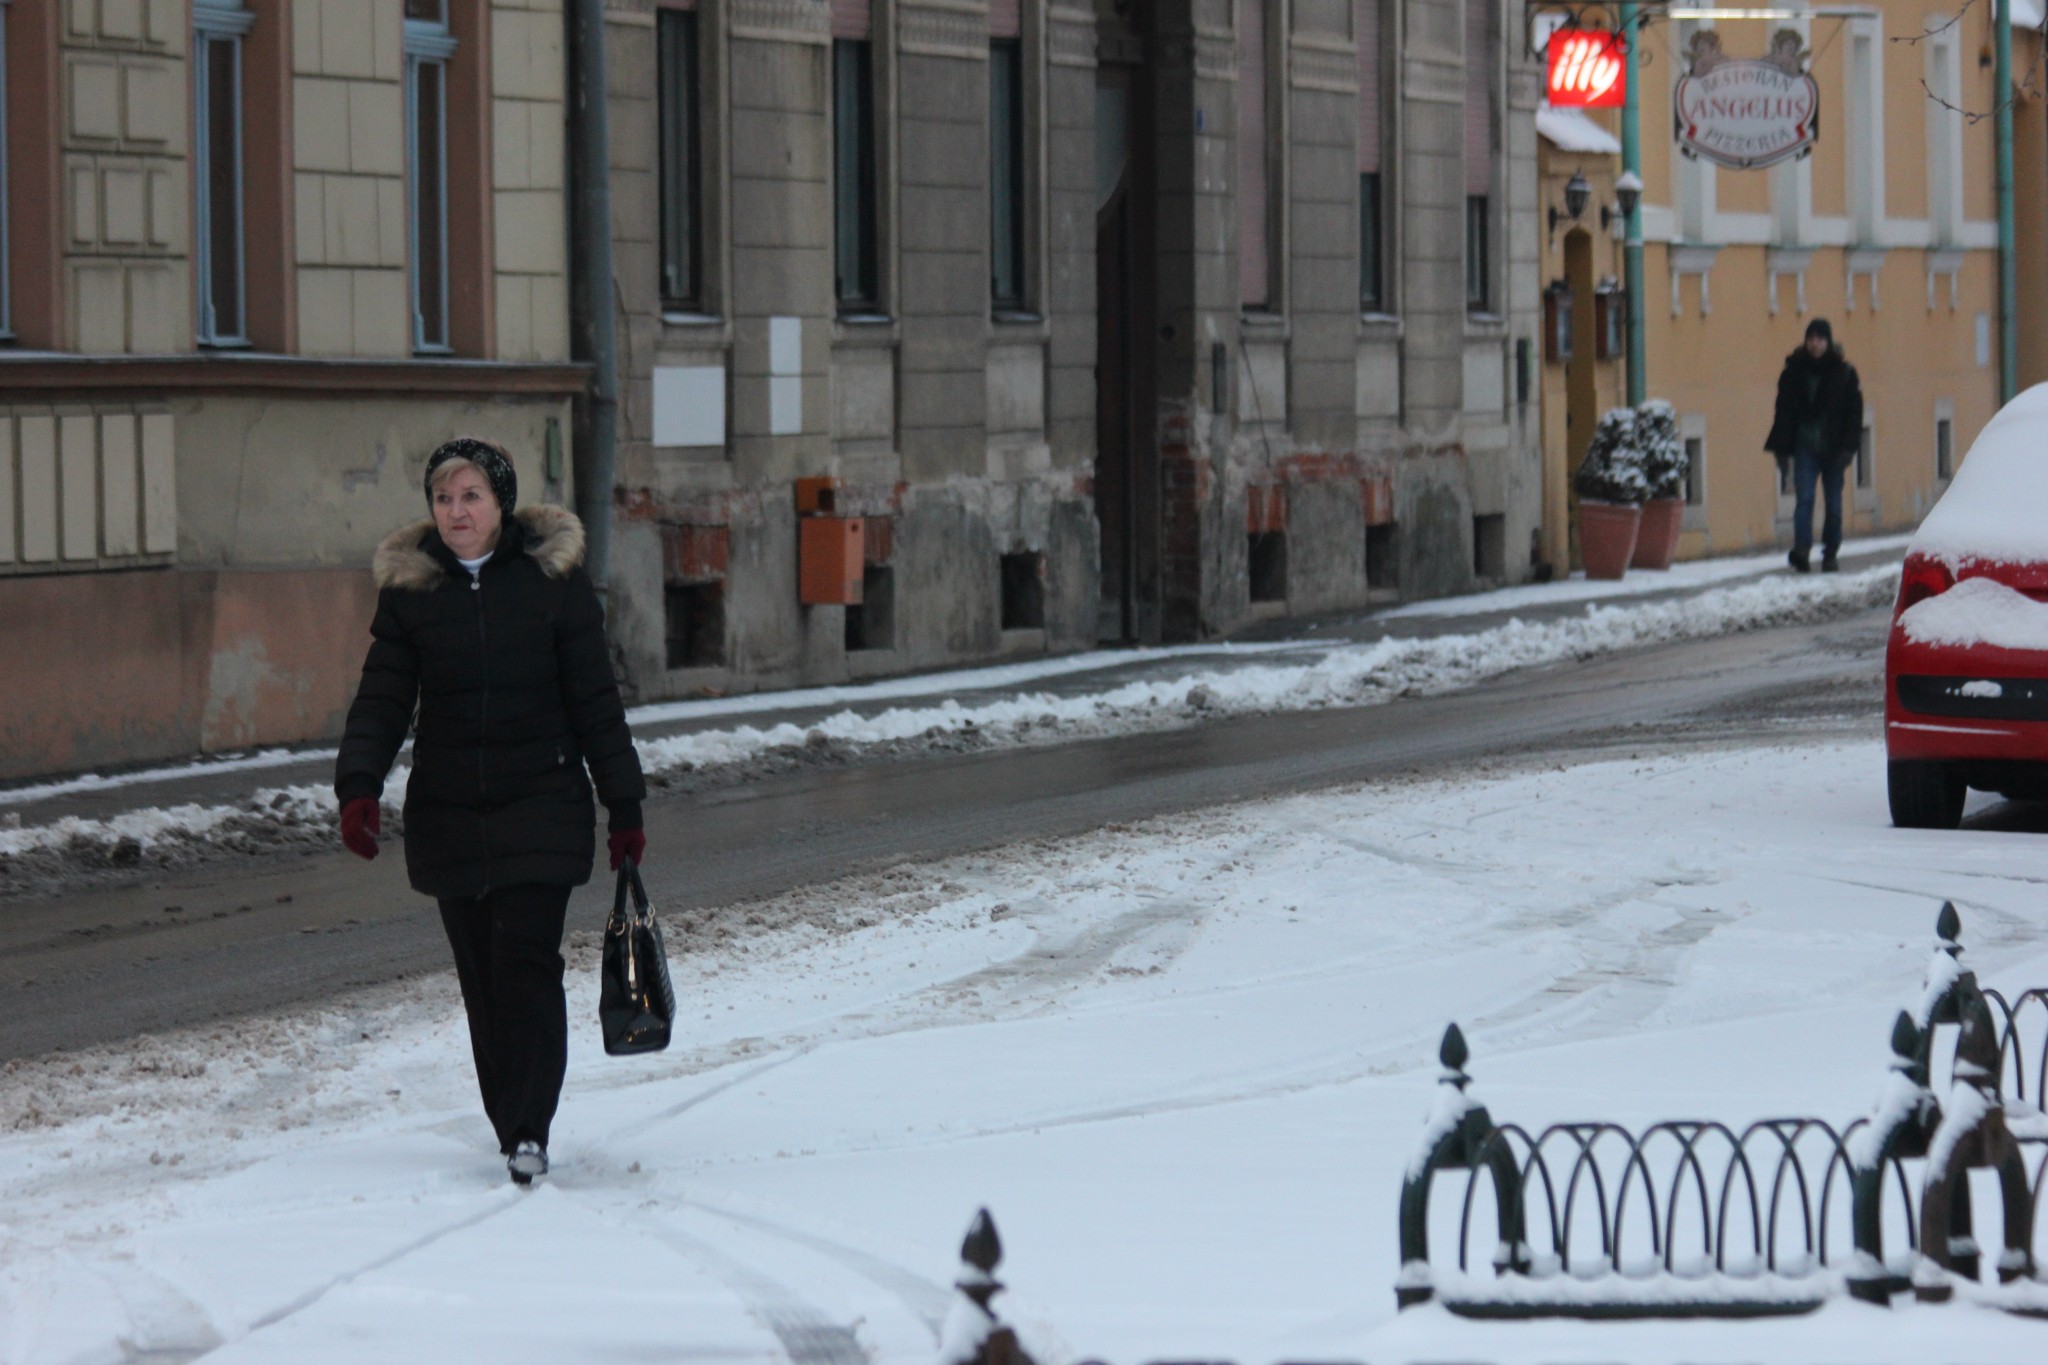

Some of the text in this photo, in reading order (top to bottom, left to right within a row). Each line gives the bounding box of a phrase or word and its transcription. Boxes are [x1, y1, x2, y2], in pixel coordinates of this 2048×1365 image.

[1551, 38, 1620, 103] illy
[1701, 69, 1793, 94] RESTORAN
[1691, 97, 1806, 119] ANGELUS
[1704, 127, 1791, 151] PIZZERIA
